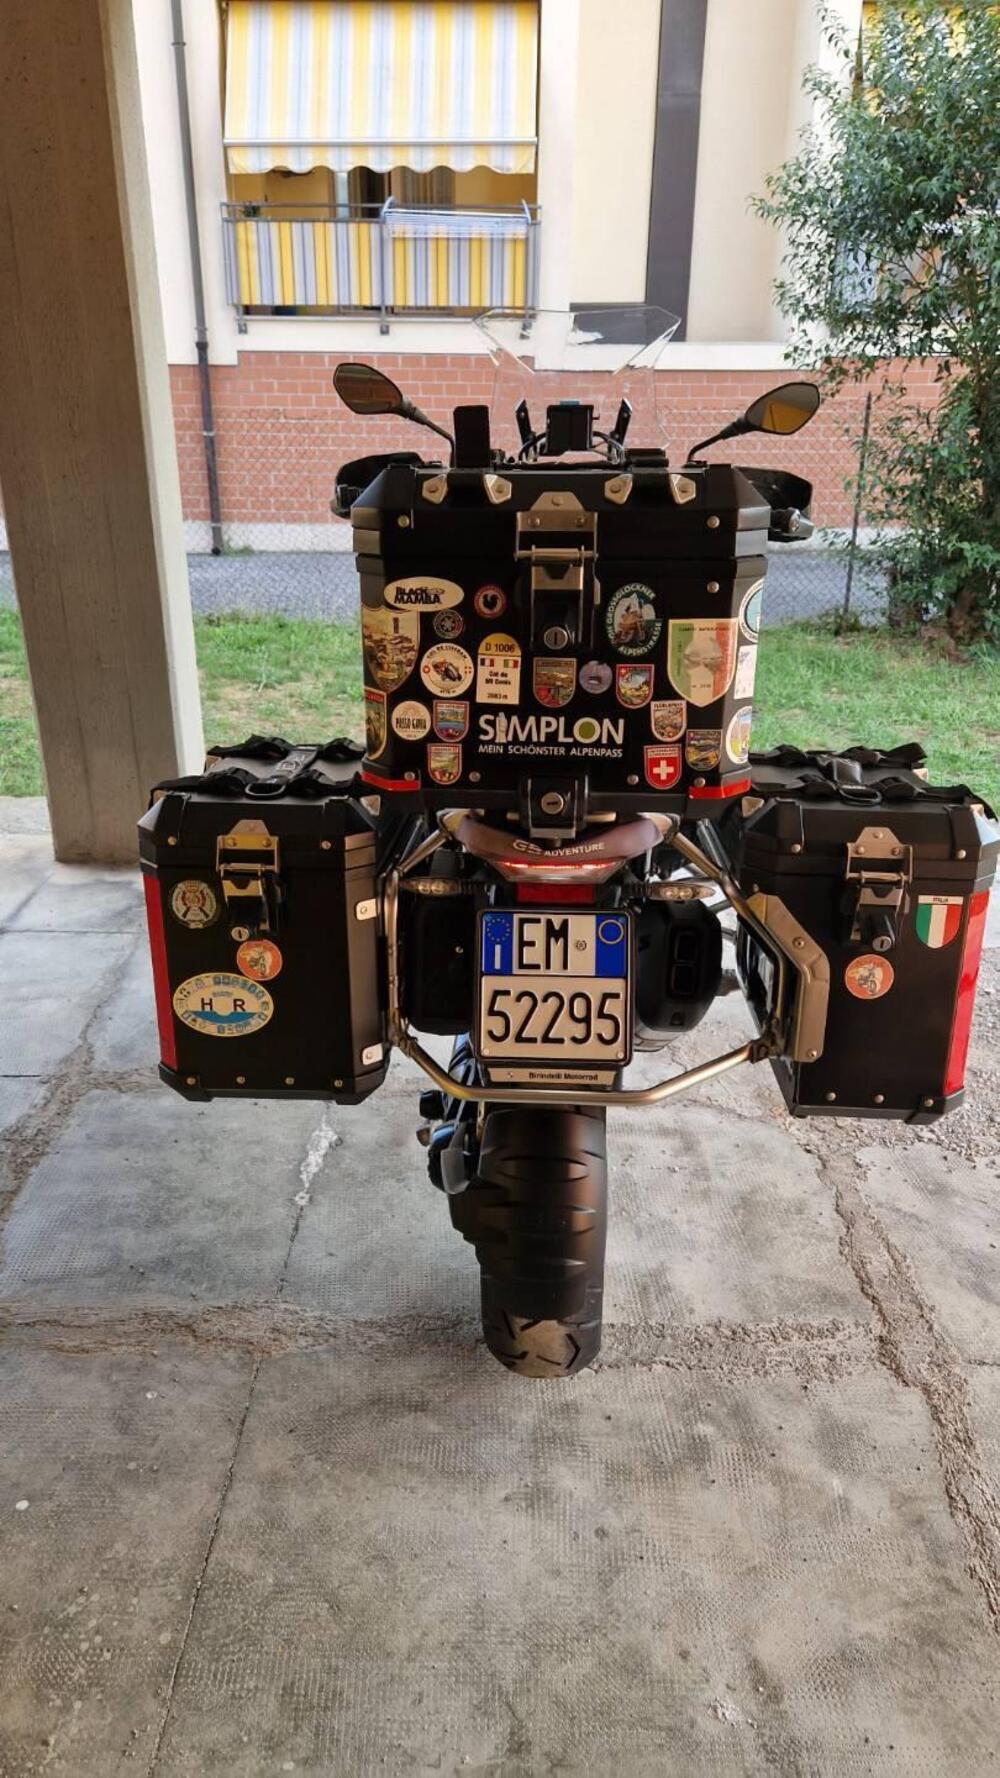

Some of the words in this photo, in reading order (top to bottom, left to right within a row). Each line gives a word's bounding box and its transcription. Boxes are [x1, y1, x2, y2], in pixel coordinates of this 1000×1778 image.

[396, 587, 428, 595] BLACK
[394, 594, 442, 604] MAMBA
[485, 643, 491, 652] D
[495, 643, 515, 653] 1006
[478, 712, 625, 744] SIMPLON
[478, 745, 503, 753] MEIN
[508, 745, 565, 755] SCHÖNSTER
[570, 747, 623, 757] ALPENPASS
[512, 840, 542, 855] GS
[544, 842, 605, 856] ADVENTURE
[518, 918, 568, 970] EM
[201, 997, 213, 1011] H
[233, 998, 246, 1012] R
[487, 990, 620, 1045] 52295
[564, 1073, 598, 1081] Motorrad
